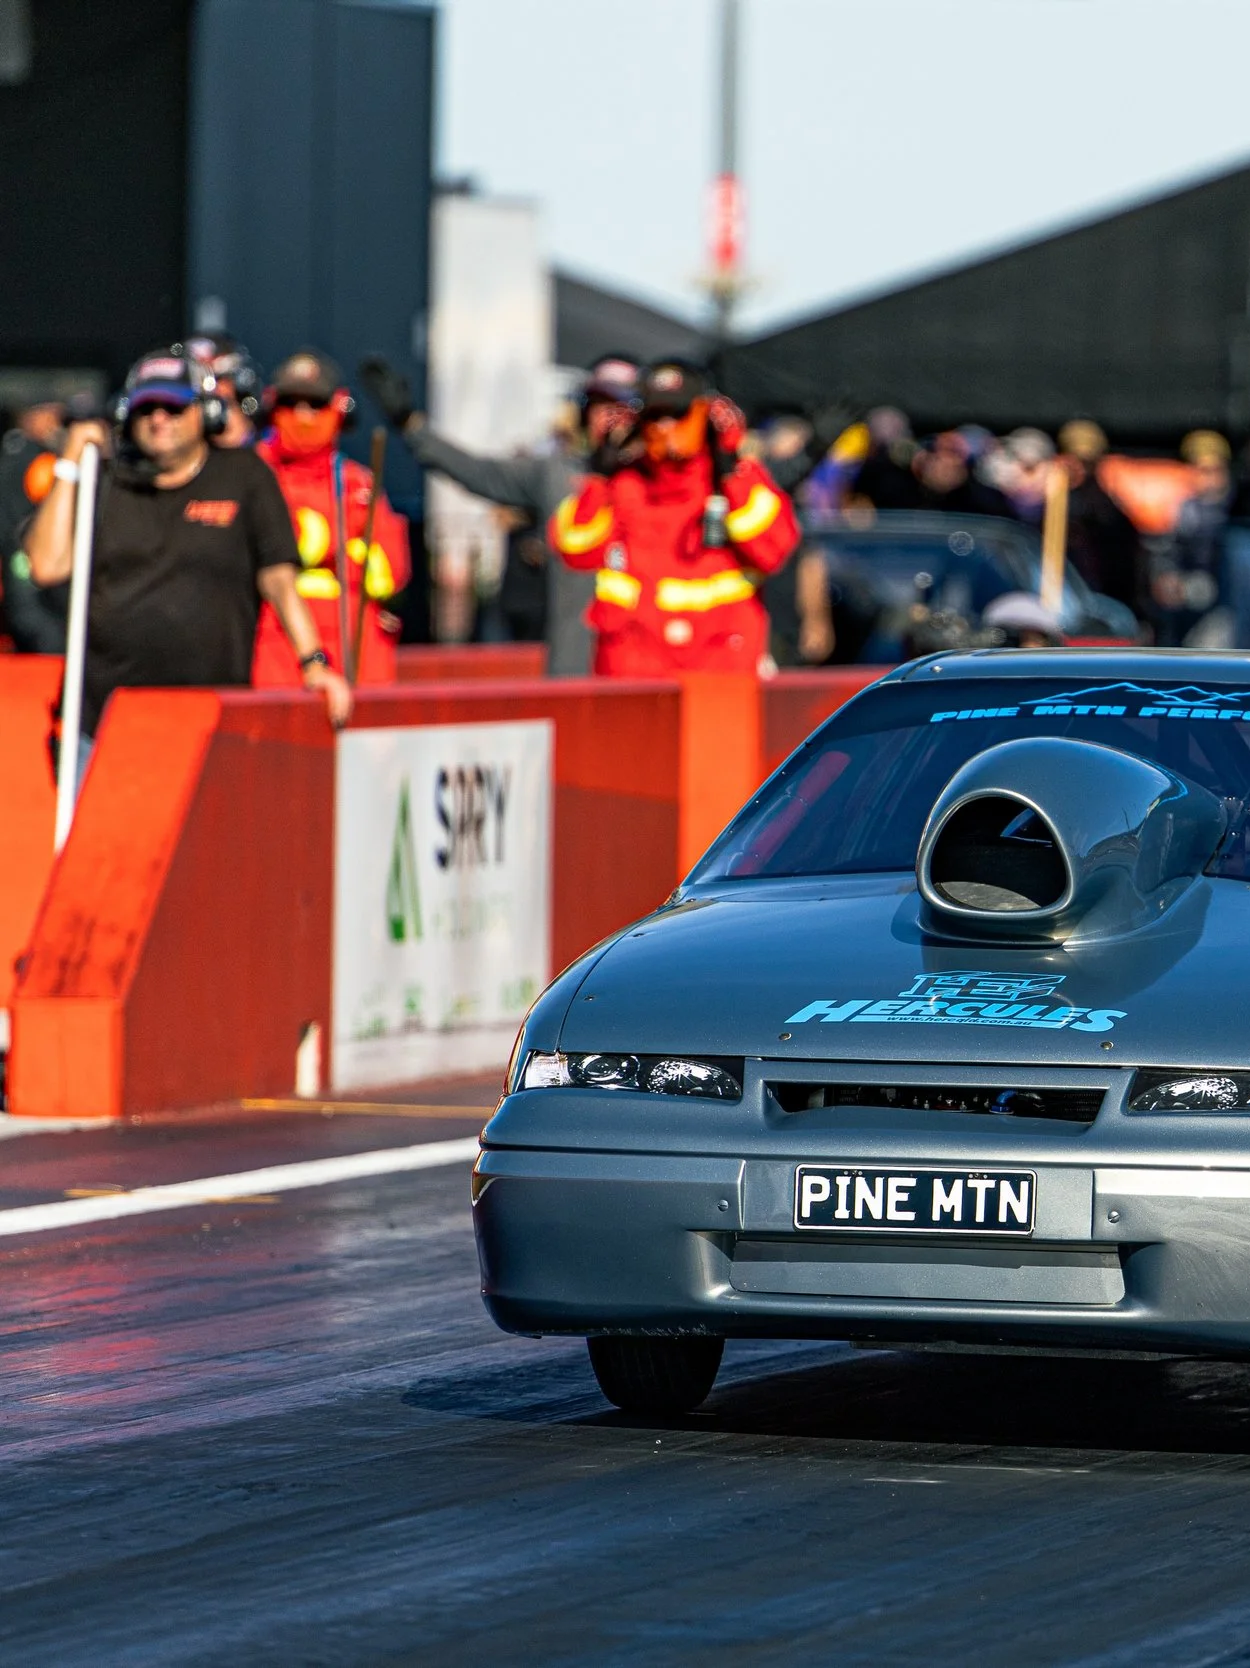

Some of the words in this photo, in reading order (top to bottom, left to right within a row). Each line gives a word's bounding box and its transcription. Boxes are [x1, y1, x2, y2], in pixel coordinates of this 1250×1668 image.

[930, 707, 1020, 722] PINE
[1033, 705, 1127, 716] MTN
[784, 999, 1128, 1032] HERCULES
[801, 1175, 917, 1221] PINE
[931, 1178, 1030, 1223] MTN
